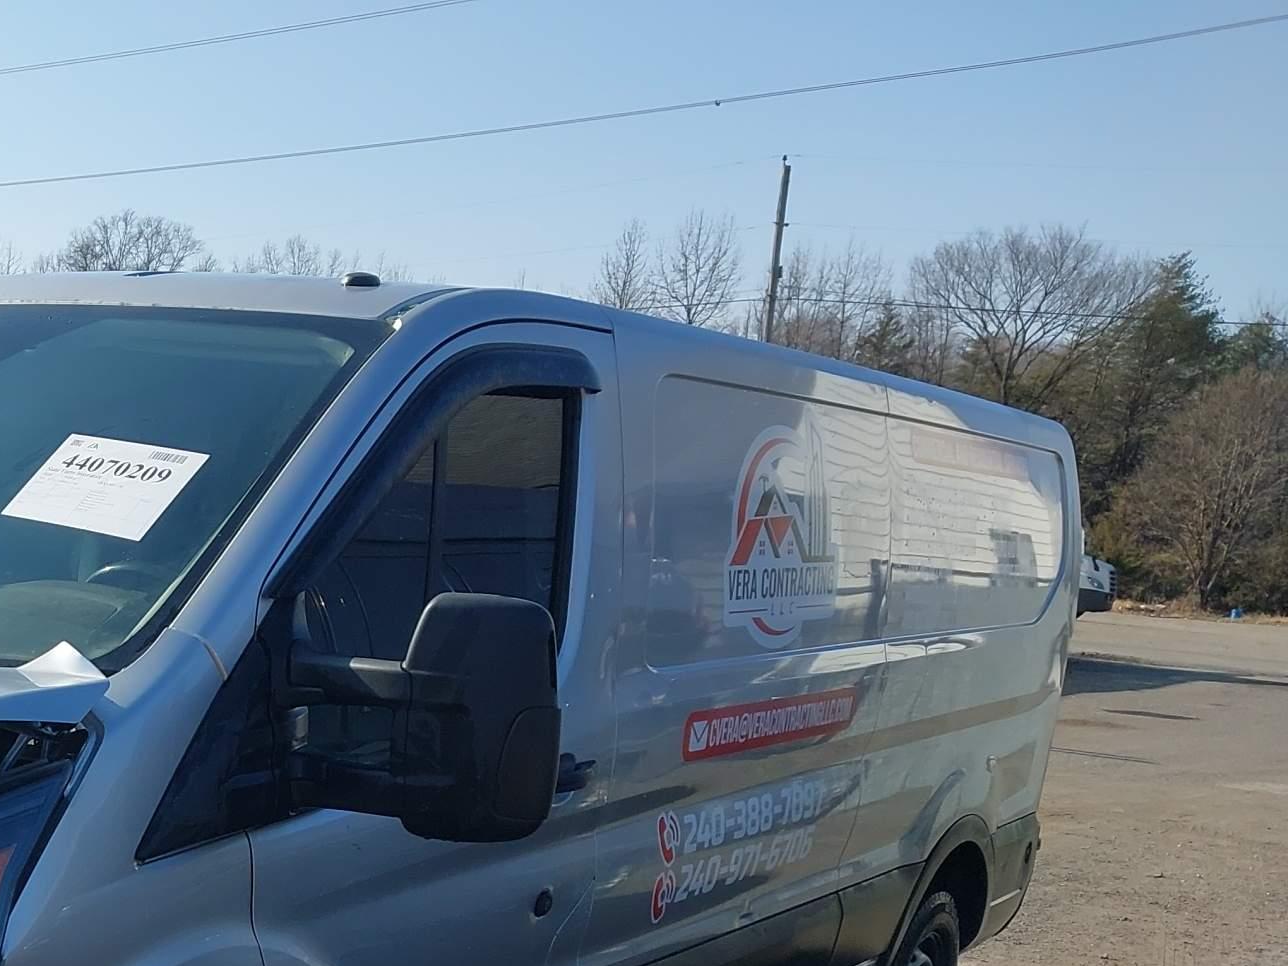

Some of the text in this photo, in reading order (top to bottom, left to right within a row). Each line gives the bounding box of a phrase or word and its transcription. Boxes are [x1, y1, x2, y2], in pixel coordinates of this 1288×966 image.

[62, 454, 172, 482] 44070209
[728, 566, 834, 600] VERA CONTRACTING
